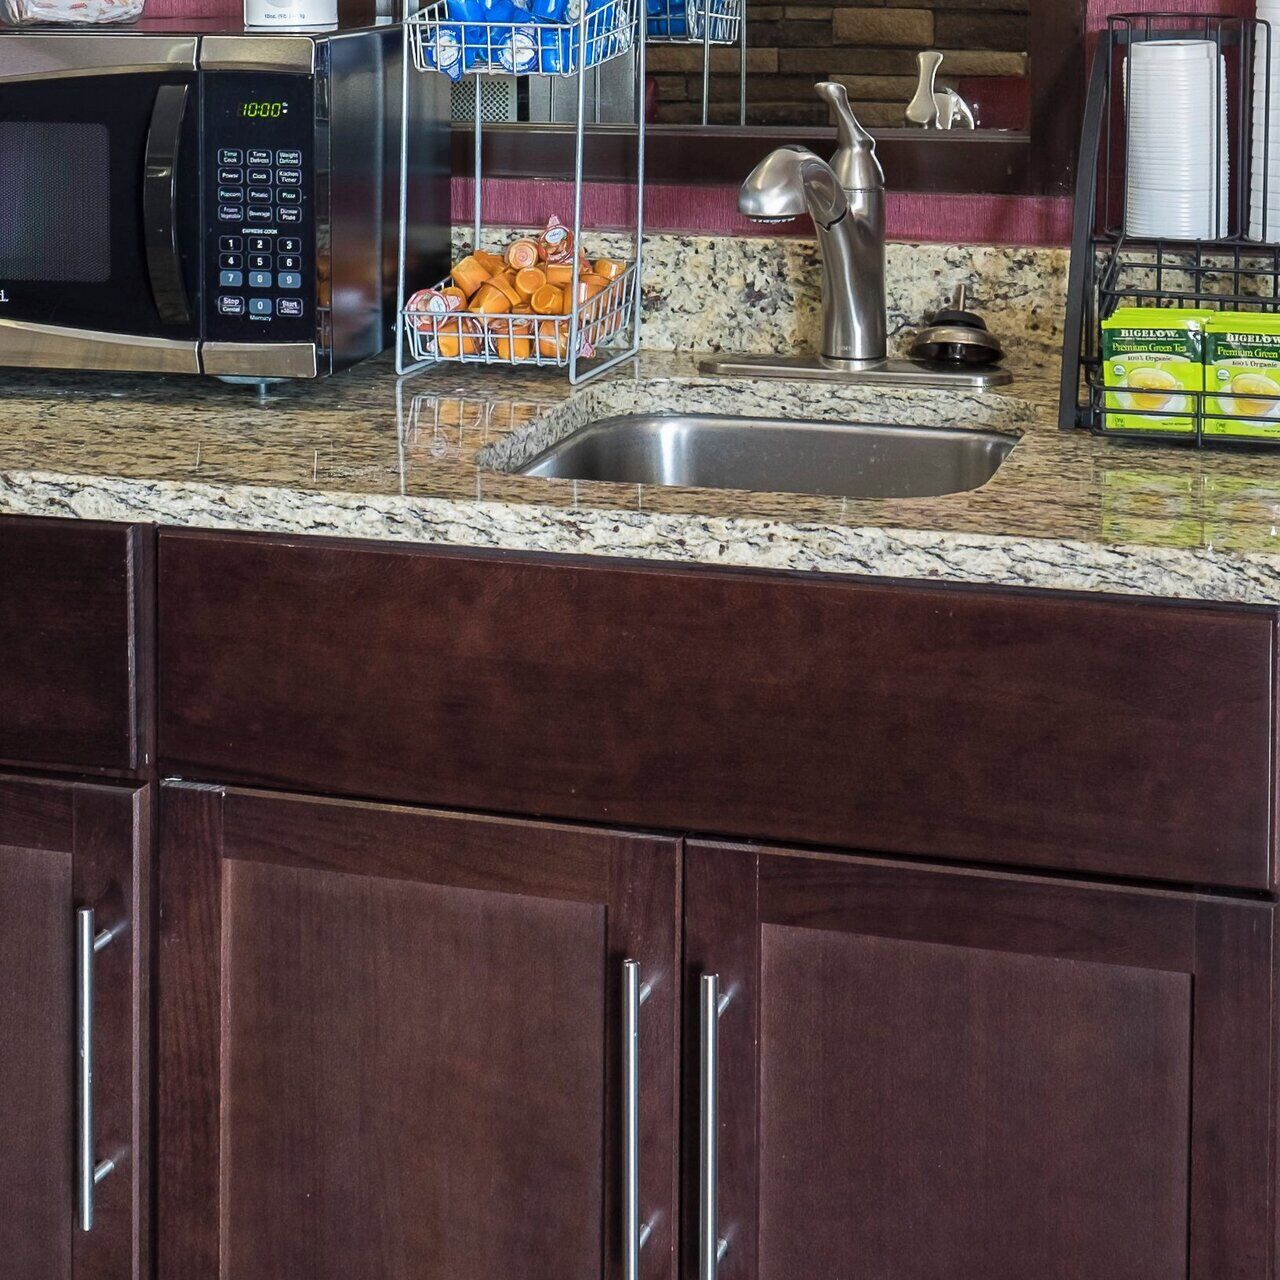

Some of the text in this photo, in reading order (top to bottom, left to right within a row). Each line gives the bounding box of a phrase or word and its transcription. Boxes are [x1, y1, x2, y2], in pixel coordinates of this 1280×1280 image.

[243, 102, 281, 117] 10:00
[279, 152, 299, 160] Weight
[228, 239, 234, 248] 1
[256, 239, 263, 248] 2
[286, 240, 293, 250] 3
[227, 256, 234, 265] 4
[257, 257, 263, 266] 5
[286, 258, 293, 267] 6
[227, 273, 234, 282] 7
[256, 274, 263, 283] 8
[286, 275, 293, 284] 9
[223, 297, 240, 305] Stop
[257, 301, 264, 310] 0
[281, 300, 298, 308] Start
[1120, 329, 1178, 337] BIGELOW
[1112, 342, 1187, 352] Premium Green Tea
[1217, 346, 1253, 357] Premium
[1254, 348, 1278, 358] Green
[1249, 360, 1278, 368] Organic
